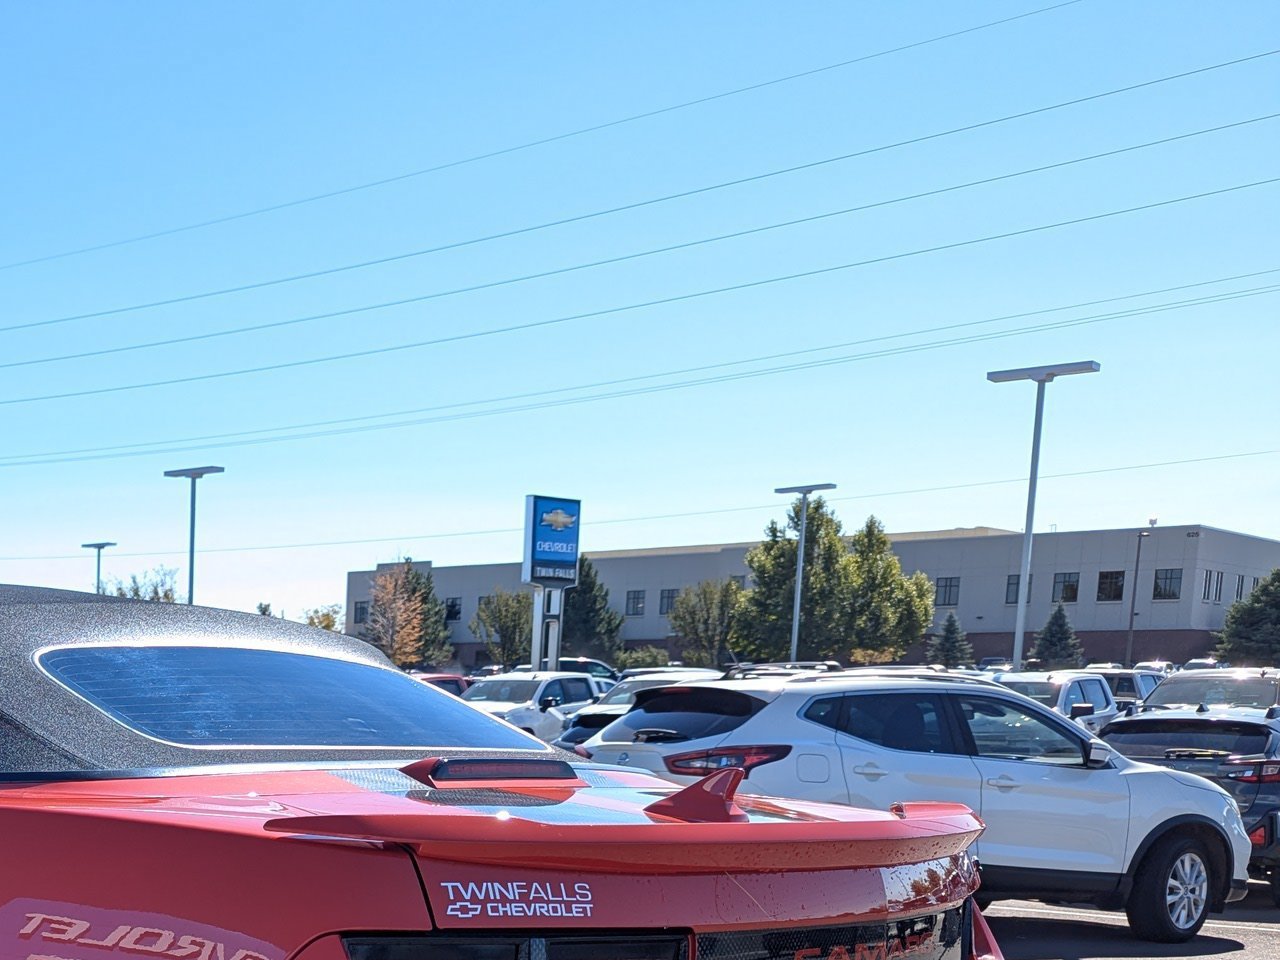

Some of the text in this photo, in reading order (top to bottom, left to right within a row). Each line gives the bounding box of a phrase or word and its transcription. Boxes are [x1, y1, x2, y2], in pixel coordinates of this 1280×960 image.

[536, 540, 576, 554] CHEVROLET
[536, 567, 575, 579] TWIN FALLS
[487, 903, 594, 917] CHEVROLET
